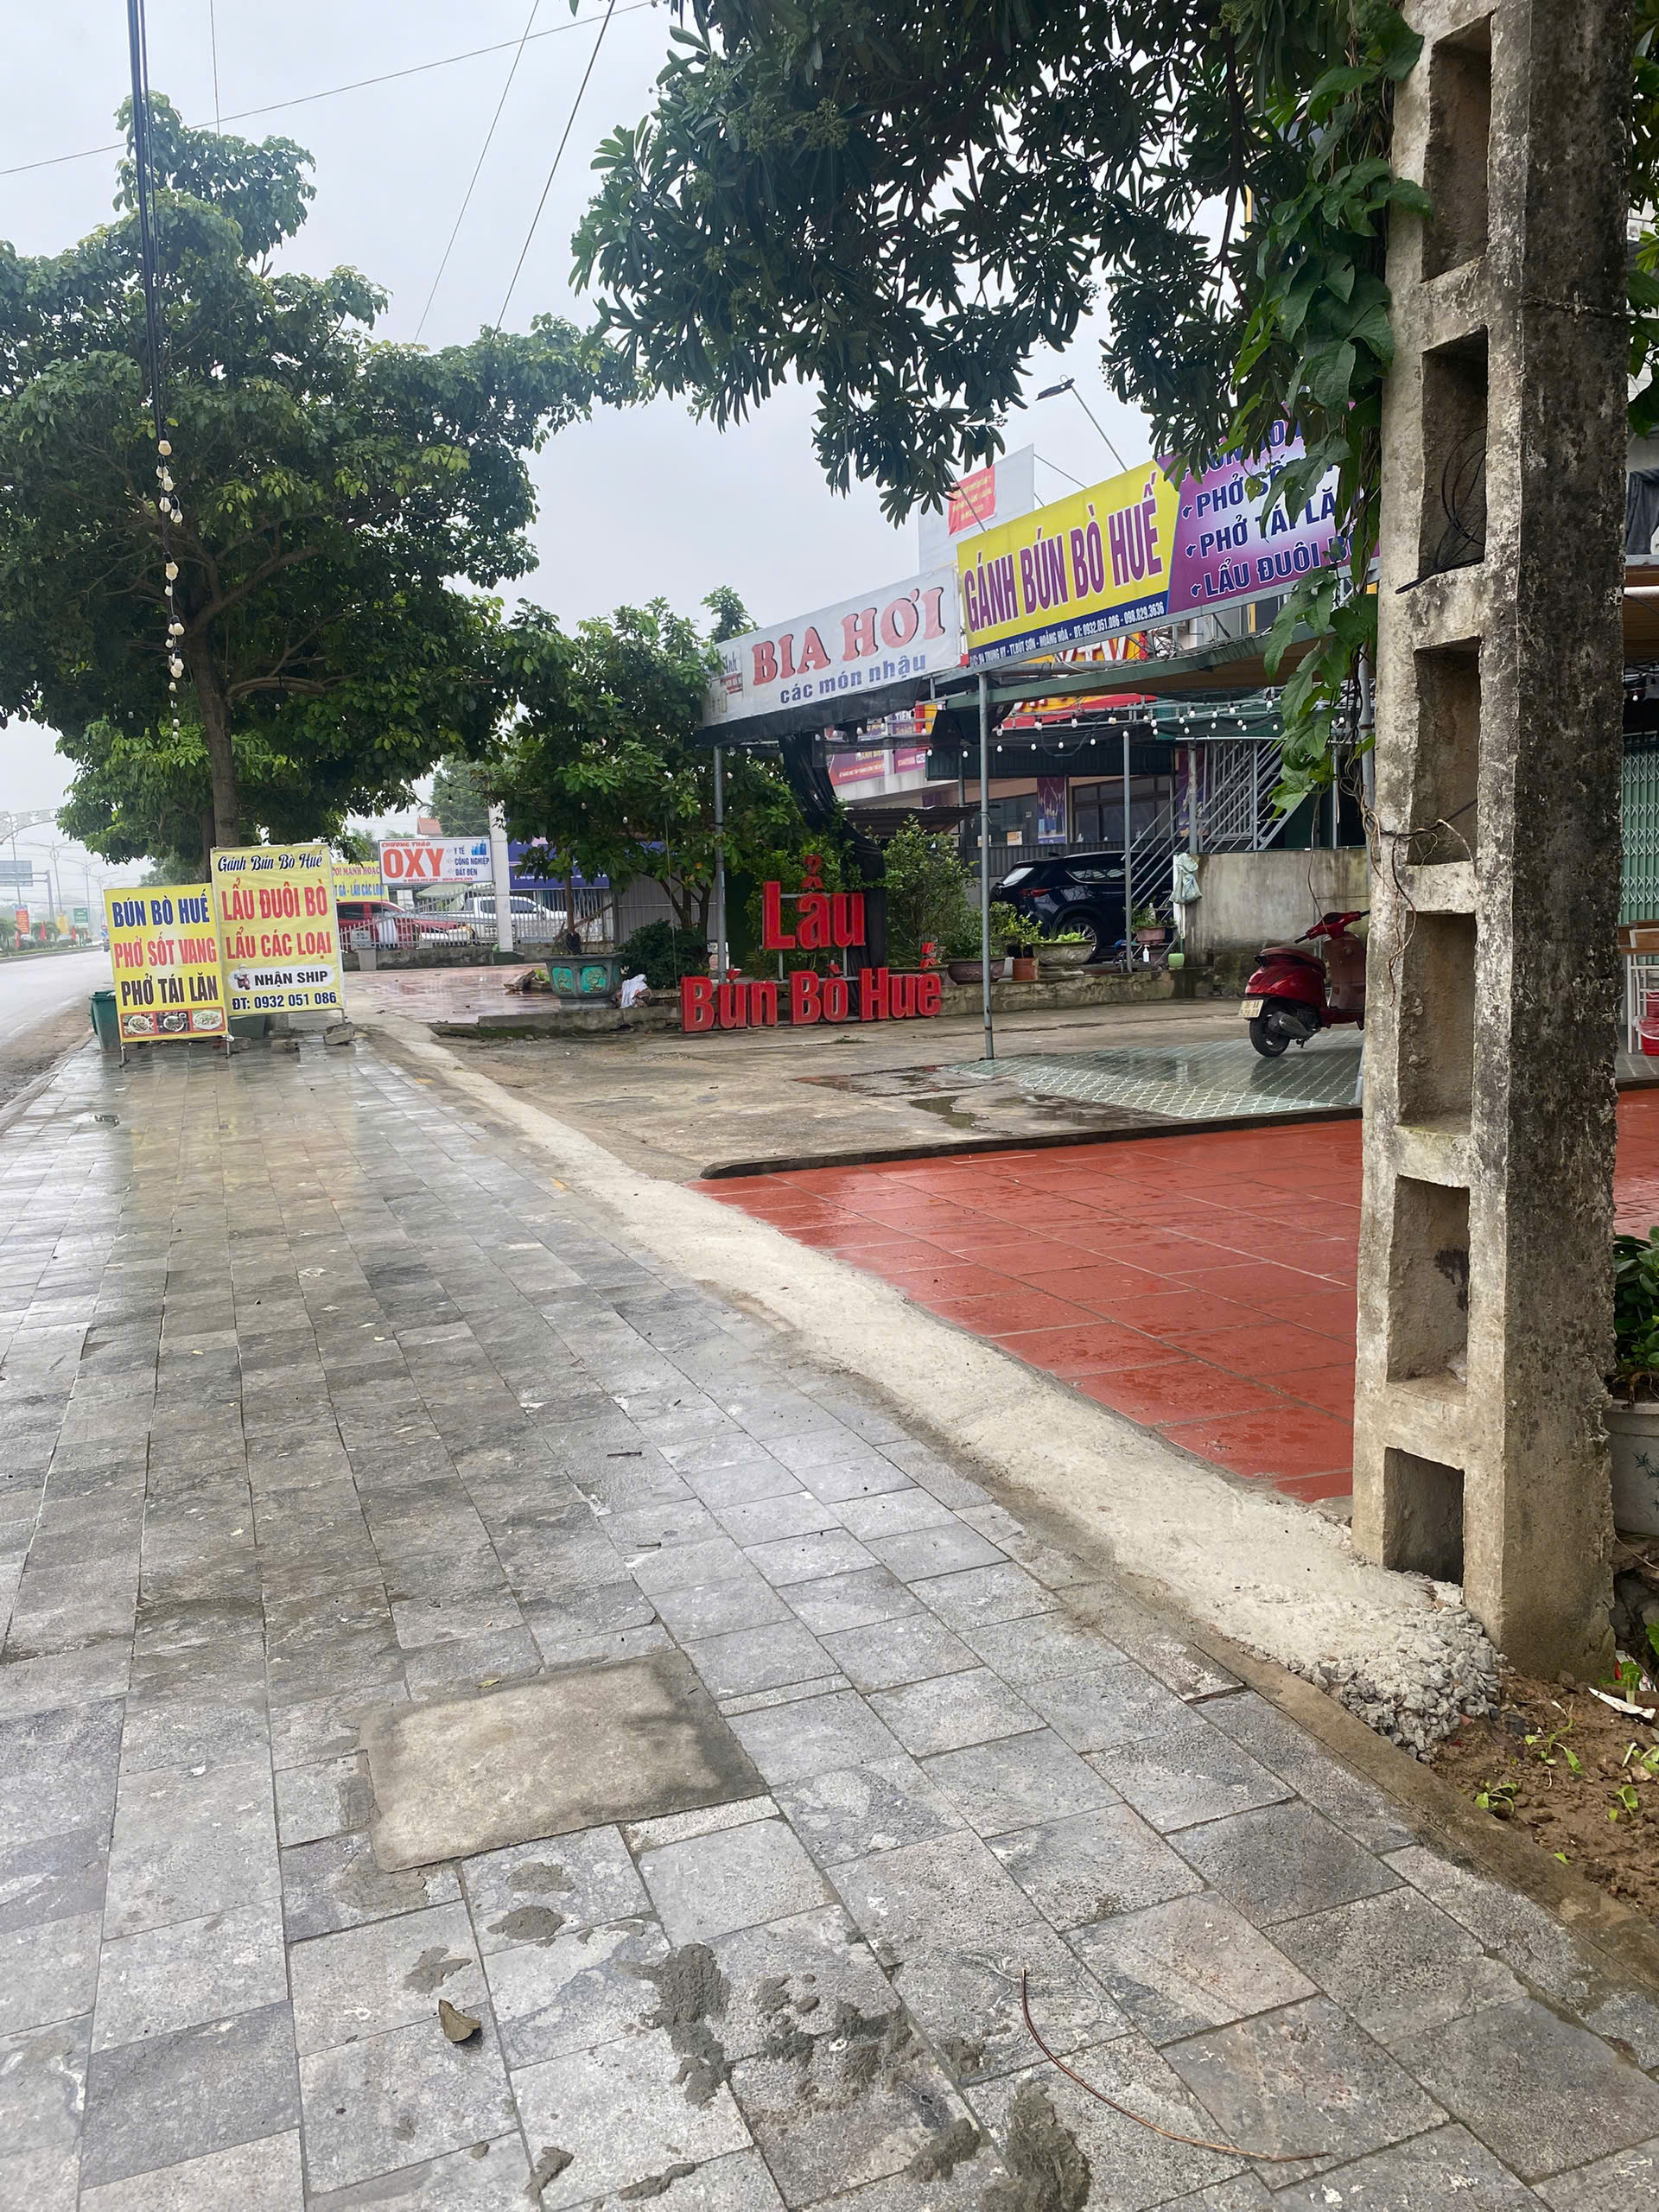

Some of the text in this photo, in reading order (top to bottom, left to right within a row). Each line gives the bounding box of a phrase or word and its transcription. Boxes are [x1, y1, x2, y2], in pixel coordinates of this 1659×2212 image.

[1196, 473, 1244, 518] PHỞ
[964, 551, 1019, 632] GÁNH
[1020, 527, 1069, 614] BÚN
[1070, 504, 1104, 599] BÒ
[1108, 472, 1163, 587] HUẾ
[1199, 514, 1248, 558] PHỞ
[1204, 558, 1250, 597] LẨU
[1257, 542, 1320, 582] ĐUÔI
[1123, 601, 1165, 624] 098.829.3636
[751, 587, 946, 687] BIA HƠI
[780, 654, 926, 704] các món nhậu
[218, 850, 323, 872] Gánh Bún Bò Huế
[383, 848, 445, 879] OXY
[454, 856, 490, 867] CÔNG NGHIỆP
[458, 844, 465, 855] TẾ
[112, 888, 210, 928] BÚN BÒ HUẾ
[221, 877, 328, 921] LẨU ĐUÔI BÒ
[763, 854, 866, 950] Lẩu
[113, 931, 218, 969] PHỞ SỐT VANG
[226, 925, 332, 960] LẨU CÁC LOẠI
[121, 971, 219, 1007] PHỞ TÁI LĂN
[254, 970, 328, 988] NHẬN SHIP
[680, 942, 942, 1033] Bún Bò Huế
[232, 991, 337, 1010] ĐT: 0932 051 086
